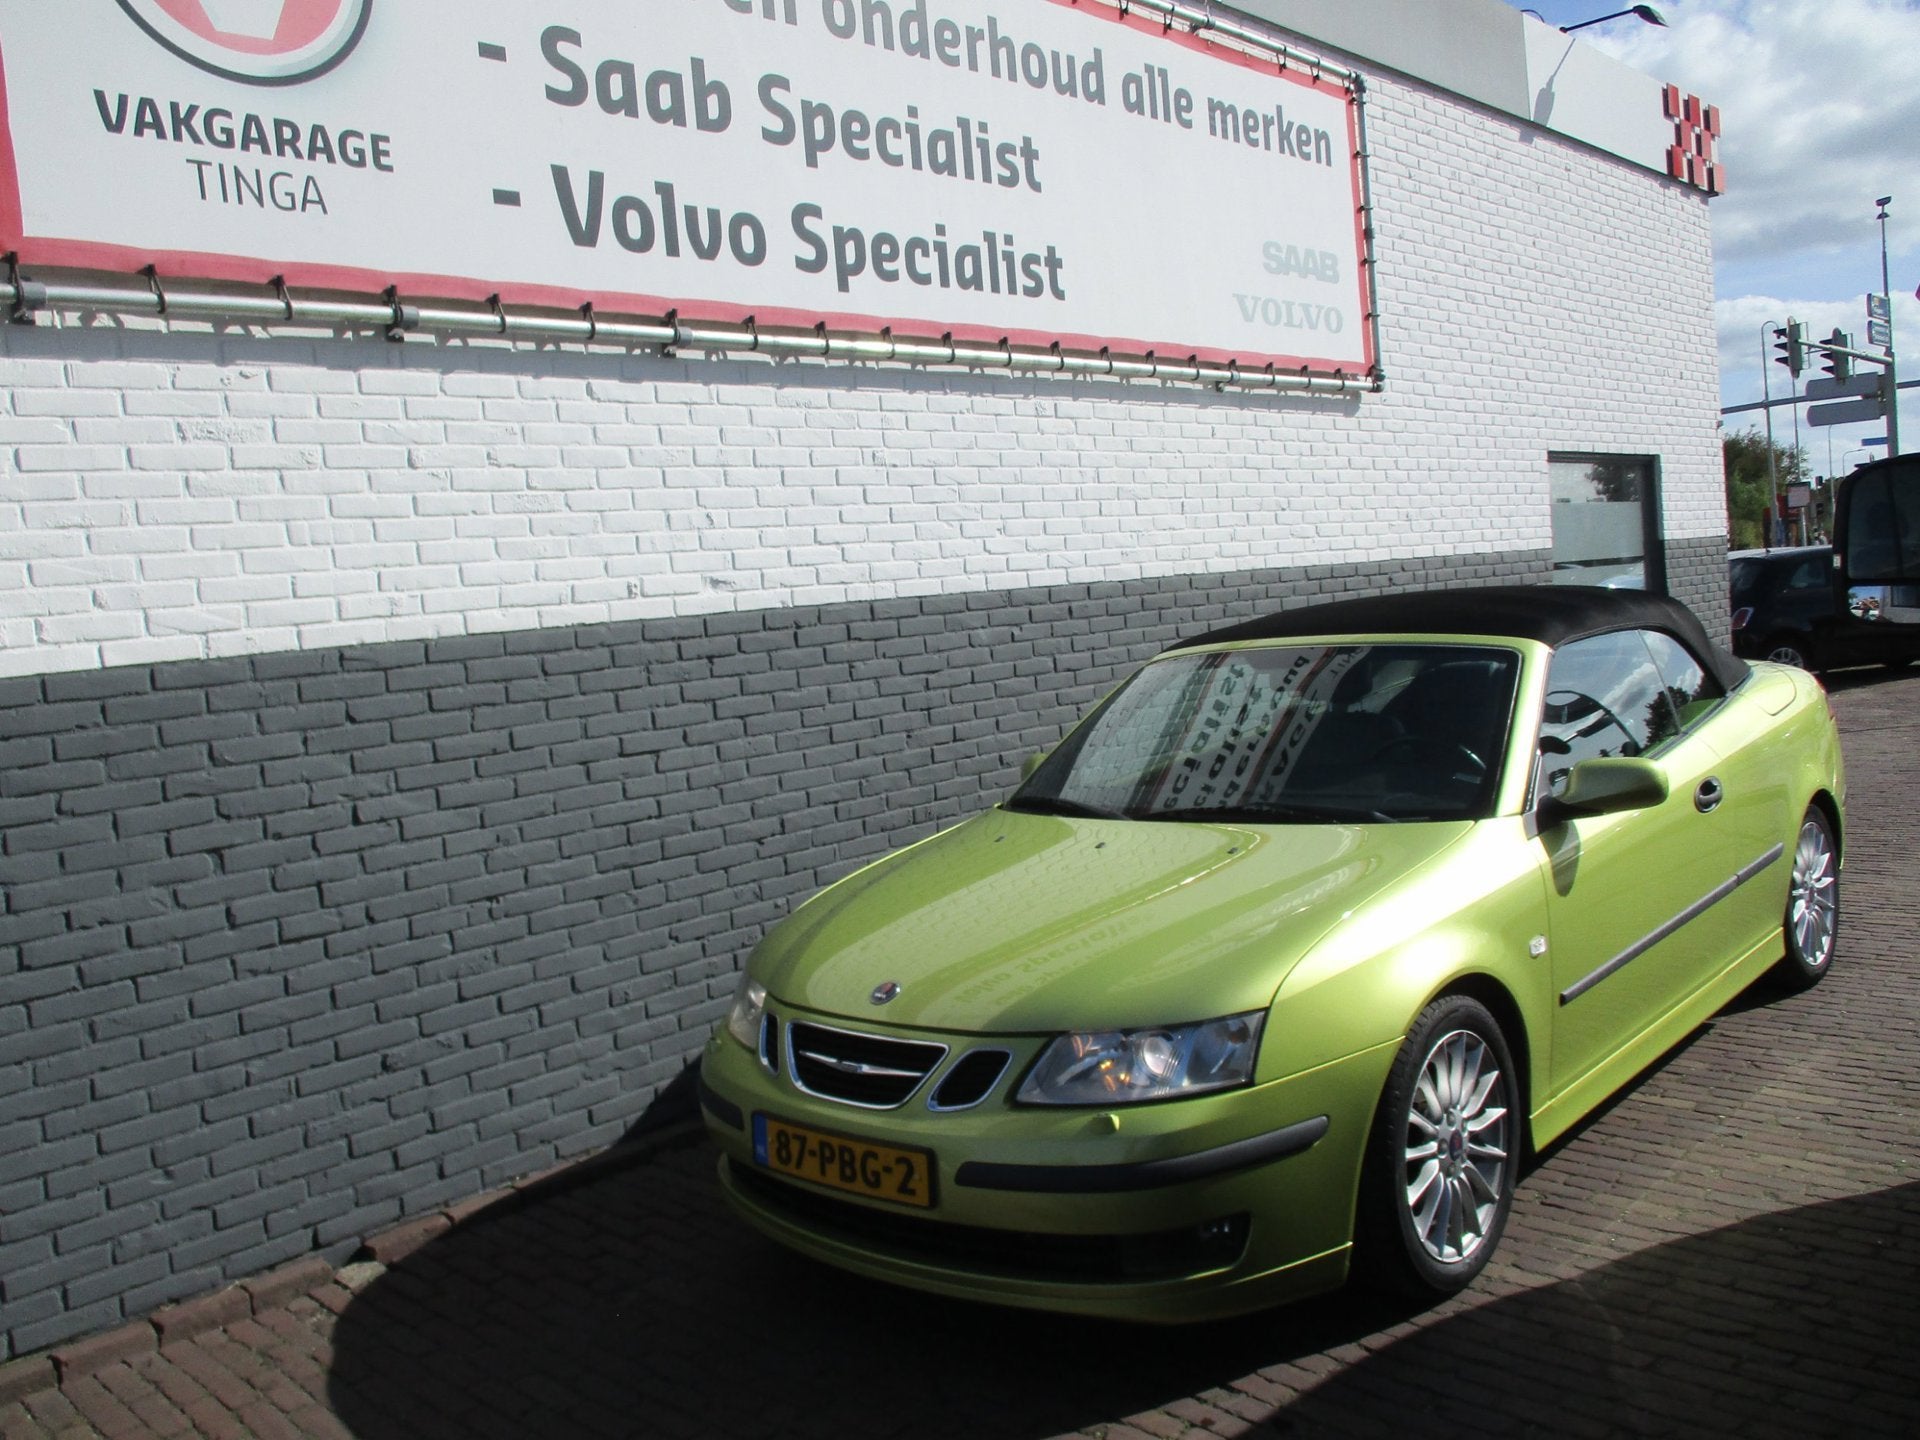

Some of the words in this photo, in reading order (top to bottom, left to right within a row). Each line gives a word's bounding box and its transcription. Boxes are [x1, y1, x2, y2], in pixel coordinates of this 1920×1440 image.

[540, 25, 732, 132] Saab
[758, 73, 1042, 193] Specialist
[822, 0, 1105, 106] onderhoud
[1122, 63, 1193, 129] alle
[1207, 97, 1331, 167] merken
[93, 88, 394, 173] VAKGARAGE
[185, 158, 329, 215] TINGA
[550, 163, 767, 267] Volvo
[790, 202, 1066, 301] Specialist
[1262, 240, 1340, 285] SAAB
[1232, 292, 1344, 334] VOLVO
[775, 1129, 917, 1196] 87-PBG-2
